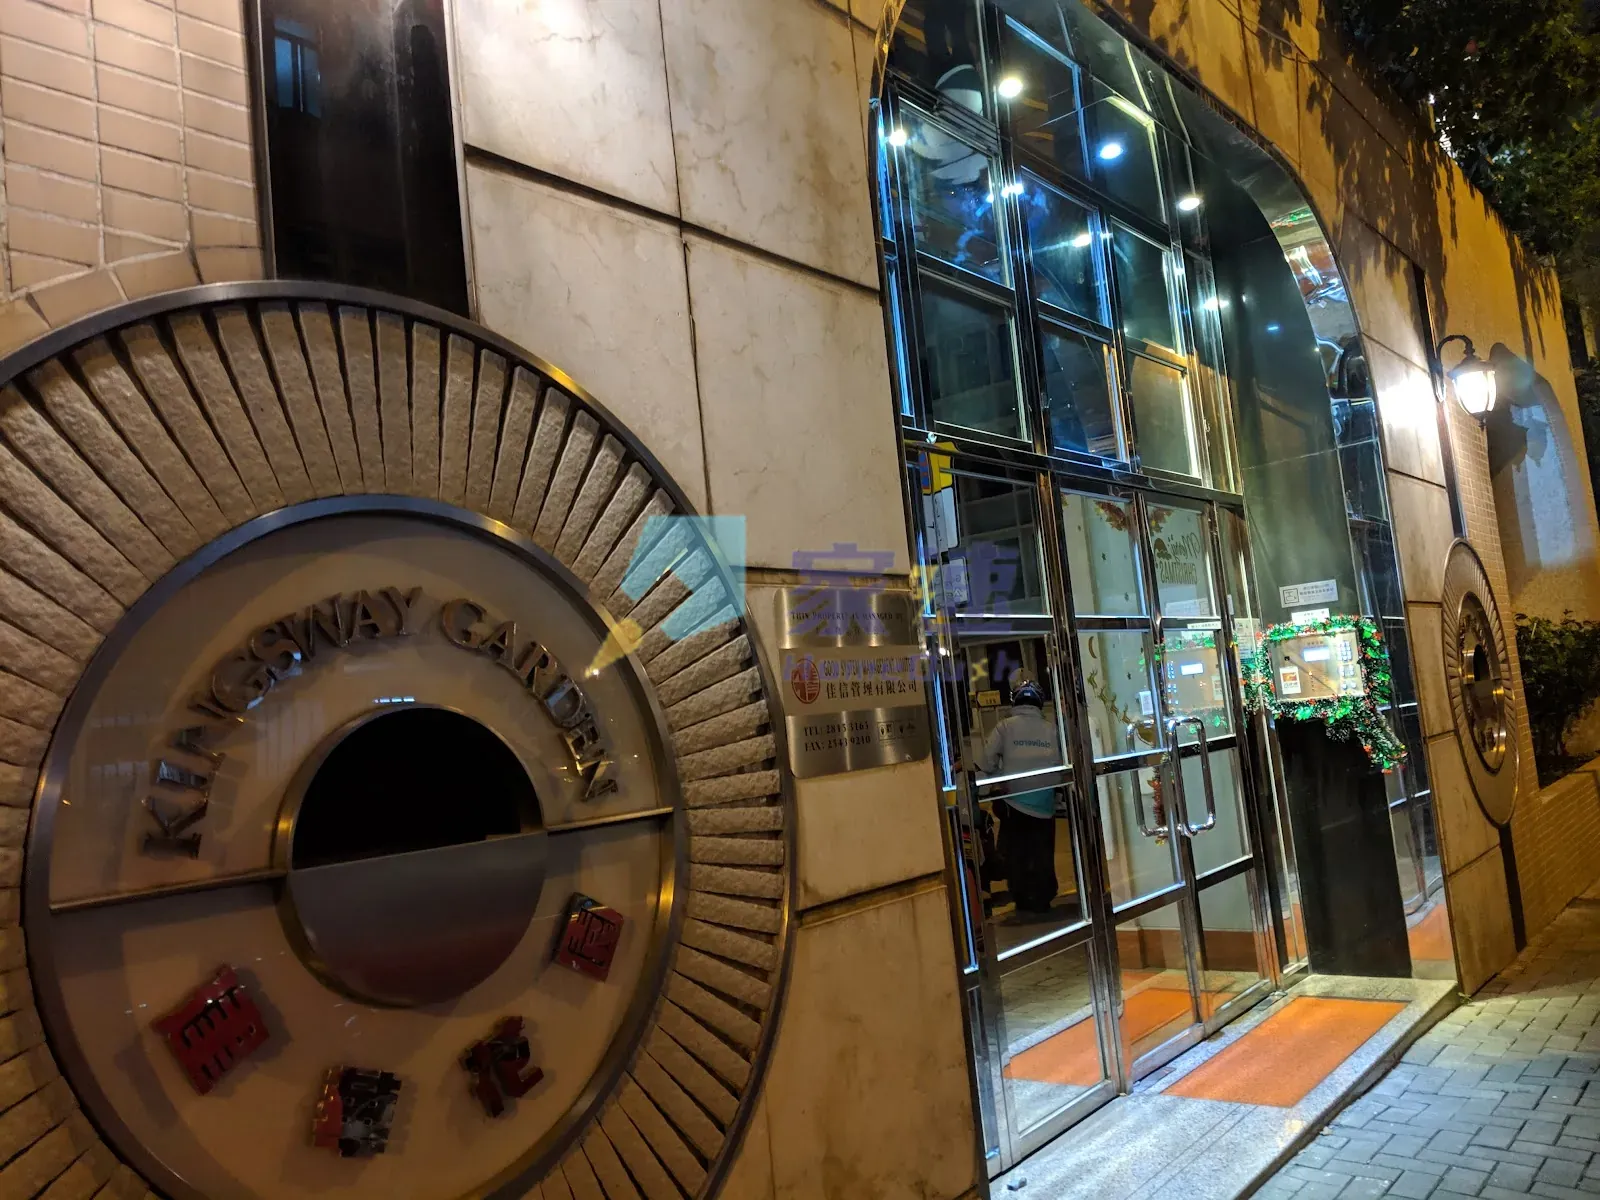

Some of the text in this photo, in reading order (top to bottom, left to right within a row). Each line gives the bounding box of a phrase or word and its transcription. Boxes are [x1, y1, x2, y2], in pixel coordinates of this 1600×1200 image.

[823, 659, 839, 677] GOOD
[862, 656, 895, 675] MANAGEMENT
[896, 656, 916, 673] LIMITED
[825, 679, 918, 699] 佳信管理有限公司
[142, 586, 423, 859] KINGSWAY
